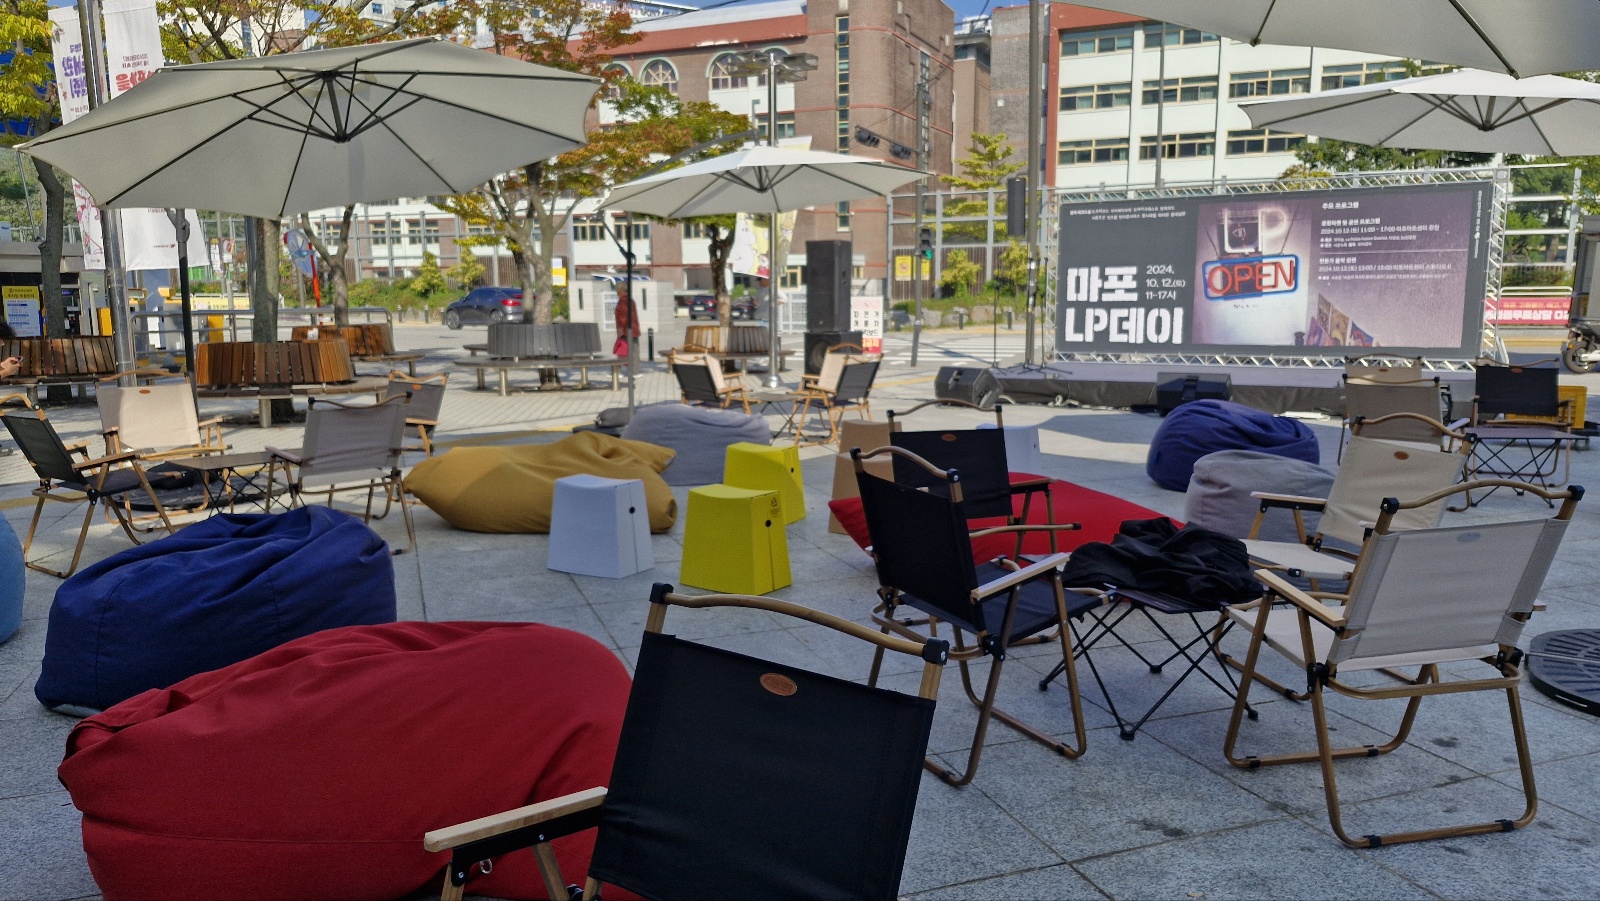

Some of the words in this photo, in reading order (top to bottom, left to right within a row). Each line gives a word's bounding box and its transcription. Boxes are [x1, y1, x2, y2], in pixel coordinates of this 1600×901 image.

[1066, 266, 1138, 302] 마포
[1208, 260, 1295, 295] OPEN
[1065, 307, 1184, 344] LP데이
